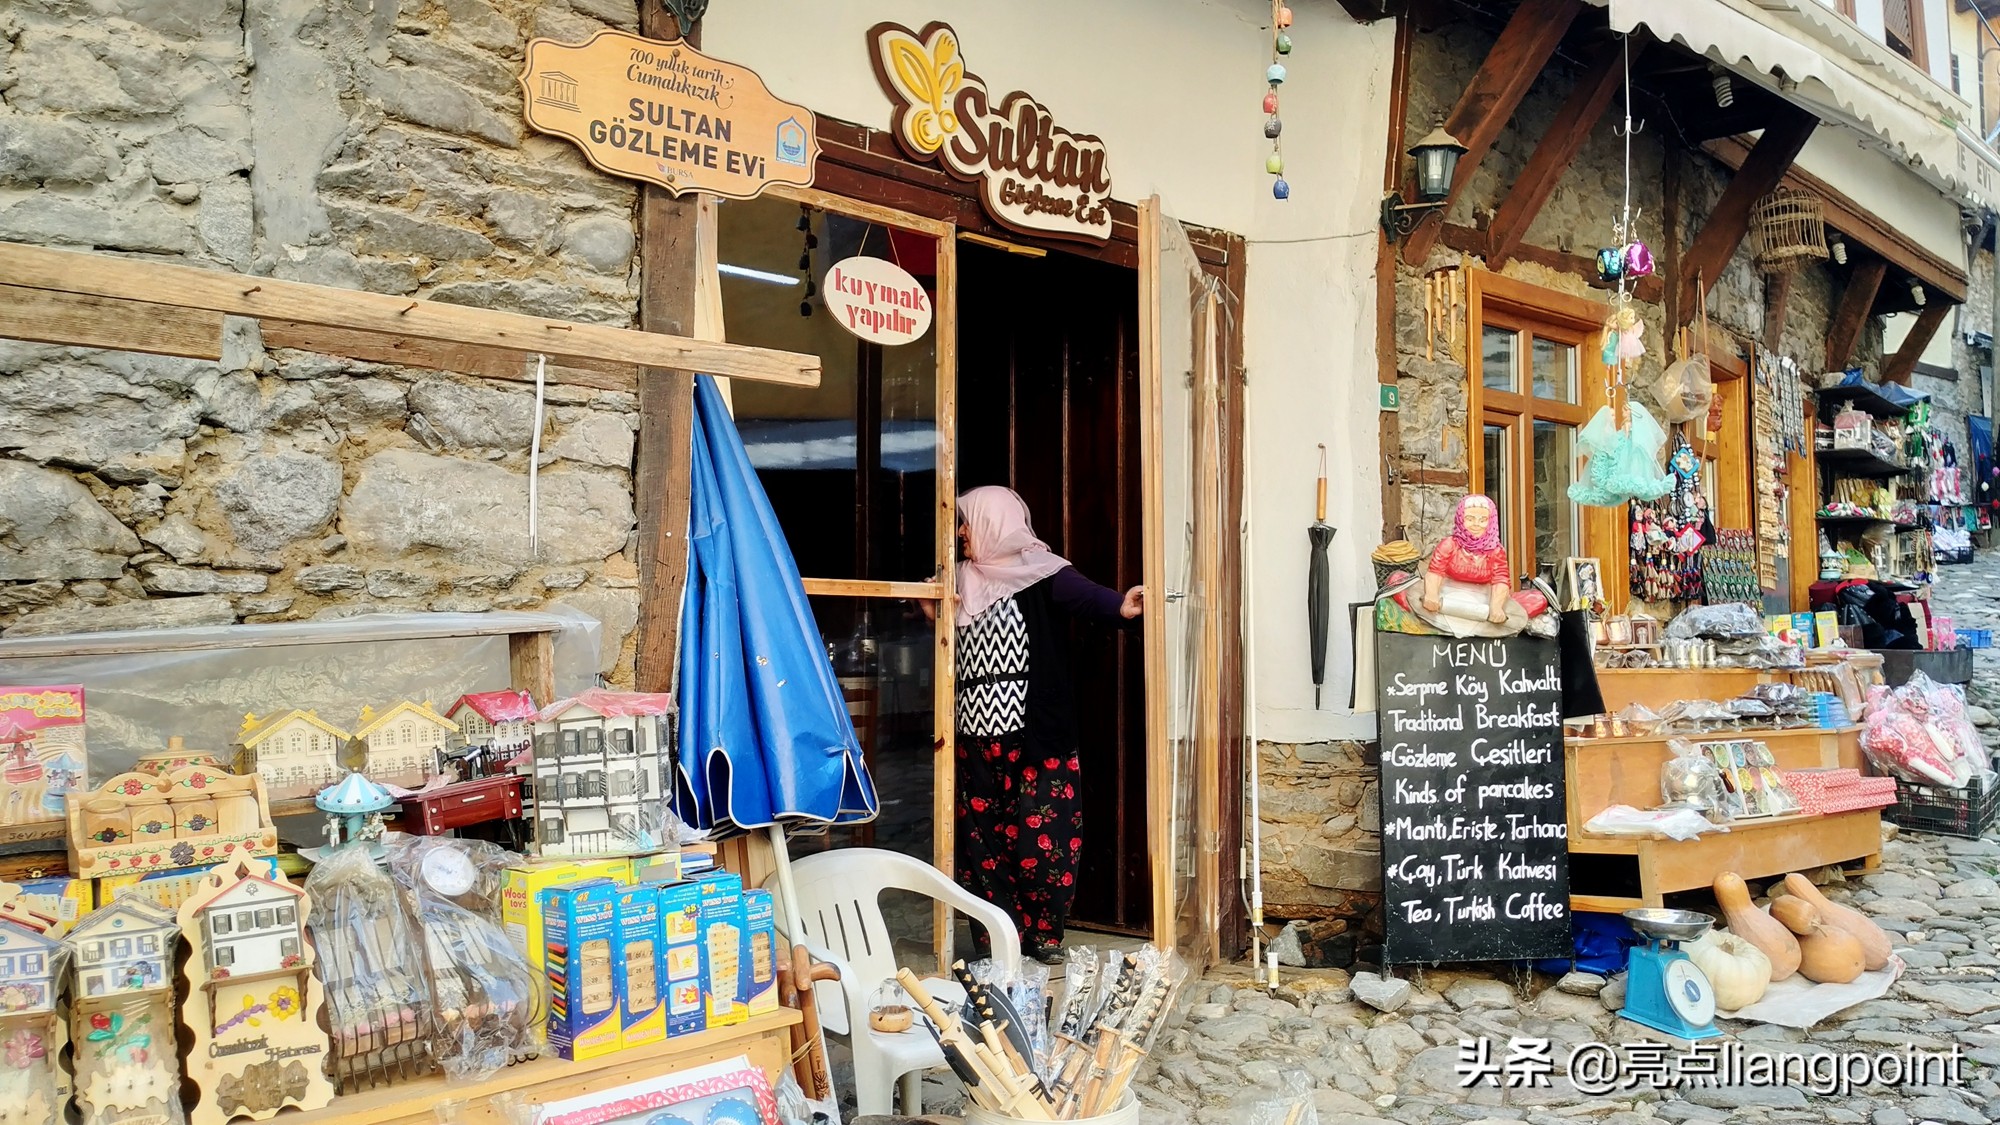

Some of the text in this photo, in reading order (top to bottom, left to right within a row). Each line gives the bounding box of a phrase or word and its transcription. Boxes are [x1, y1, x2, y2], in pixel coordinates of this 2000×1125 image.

[630, 48, 654, 65] 700
[691, 67, 734, 90] tarih
[628, 98, 732, 143] SULTAN
[589, 118, 718, 170] GÖZLEME
[950, 86, 1110, 193] Sultan
[667, 167, 694, 180] BURSA
[1000, 178, 1107, 225] Gözleme Evi
[835, 268, 925, 311] kuymak
[845, 304, 917, 335] yapılır
[1389, 392, 1395, 405] 9
[1432, 640, 1507, 668] MENÜ
[1456, 674, 1489, 703] Köy
[1499, 665, 1563, 695] Kahvaltı
[1388, 702, 1560, 732] Traditional Breakfast
[1395, 774, 1554, 809] Kinds of pancakes
[1505, 814, 1567, 841] Tarhana
[1499, 852, 1557, 882] Kahvesi
[503, 887, 527, 900] Wood
[510, 899, 527, 909] toys
[1444, 896, 1496, 924] Turkish
[1505, 893, 1564, 921] Coffee
[585, 1109, 606, 1120] Türk
